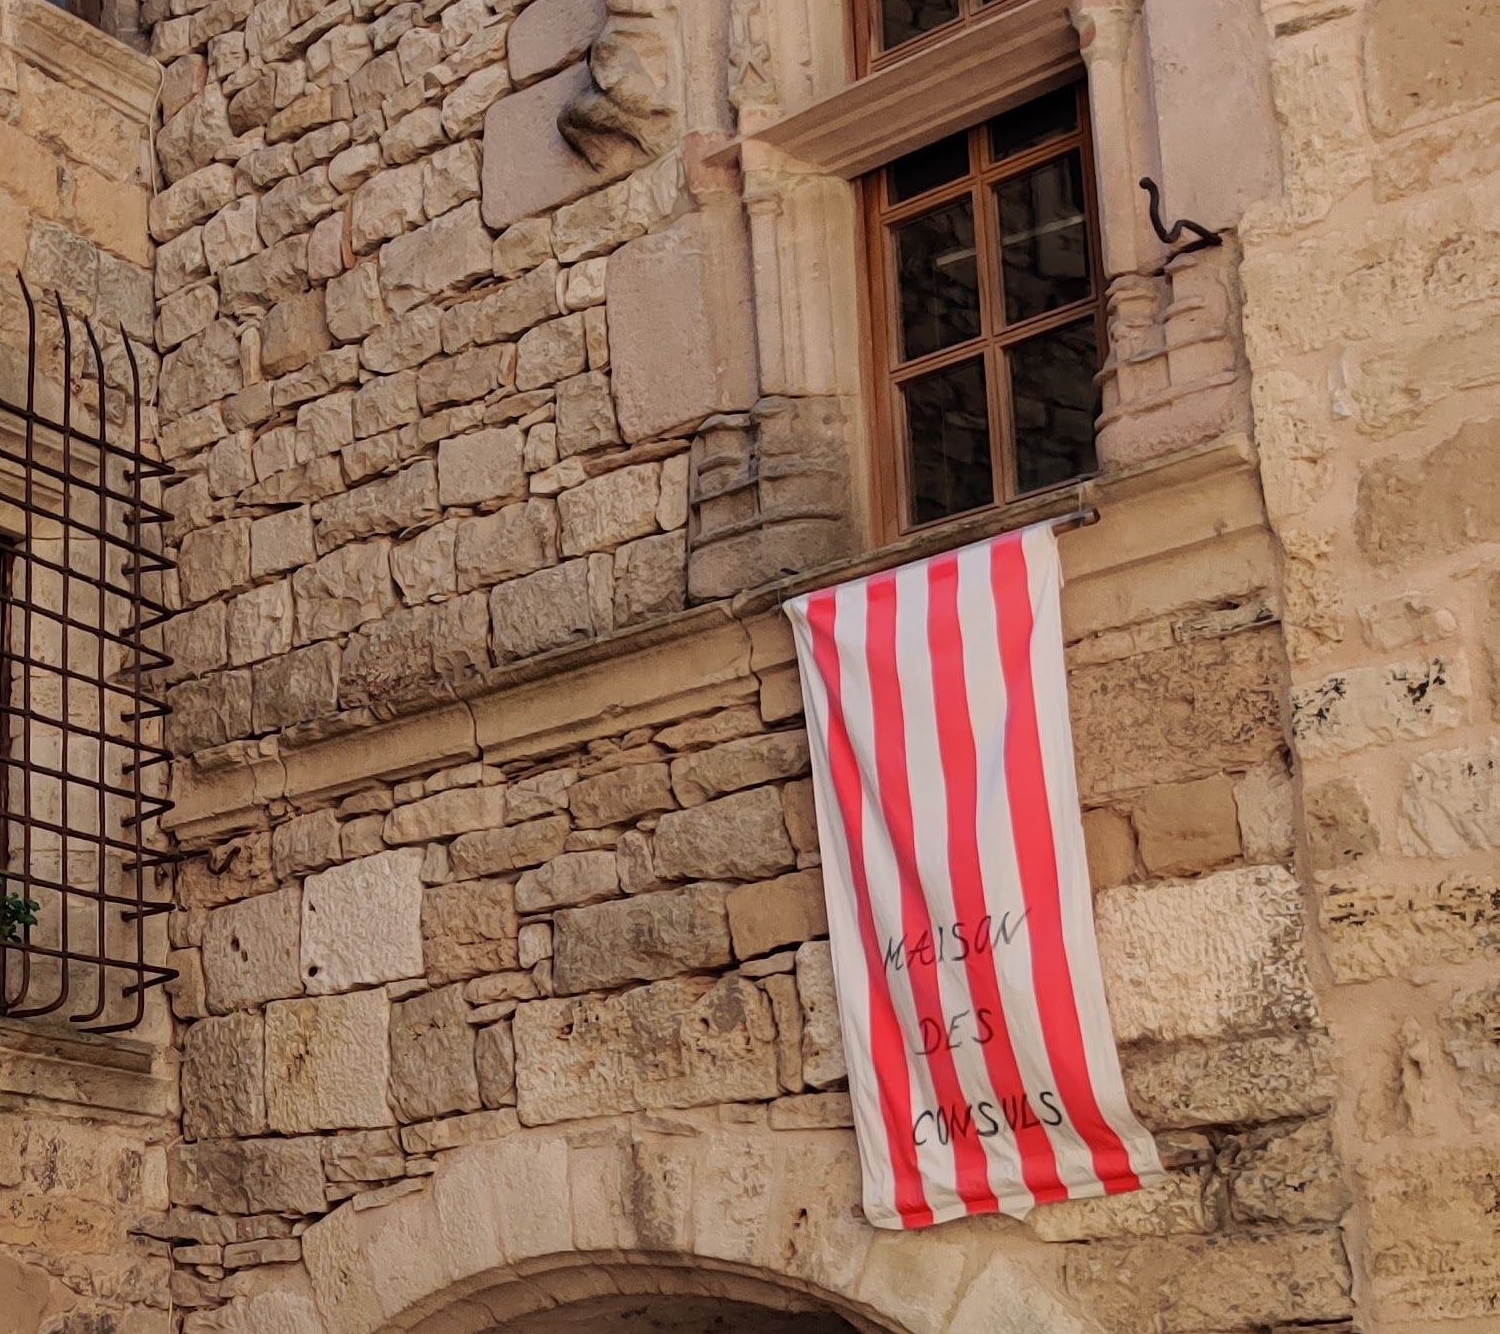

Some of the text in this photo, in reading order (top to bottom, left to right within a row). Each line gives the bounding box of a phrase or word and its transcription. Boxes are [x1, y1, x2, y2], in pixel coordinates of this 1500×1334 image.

[883, 907, 1032, 977] MAISON
[914, 1008, 994, 1055] DES
[912, 1091, 1062, 1146] CONSULS
